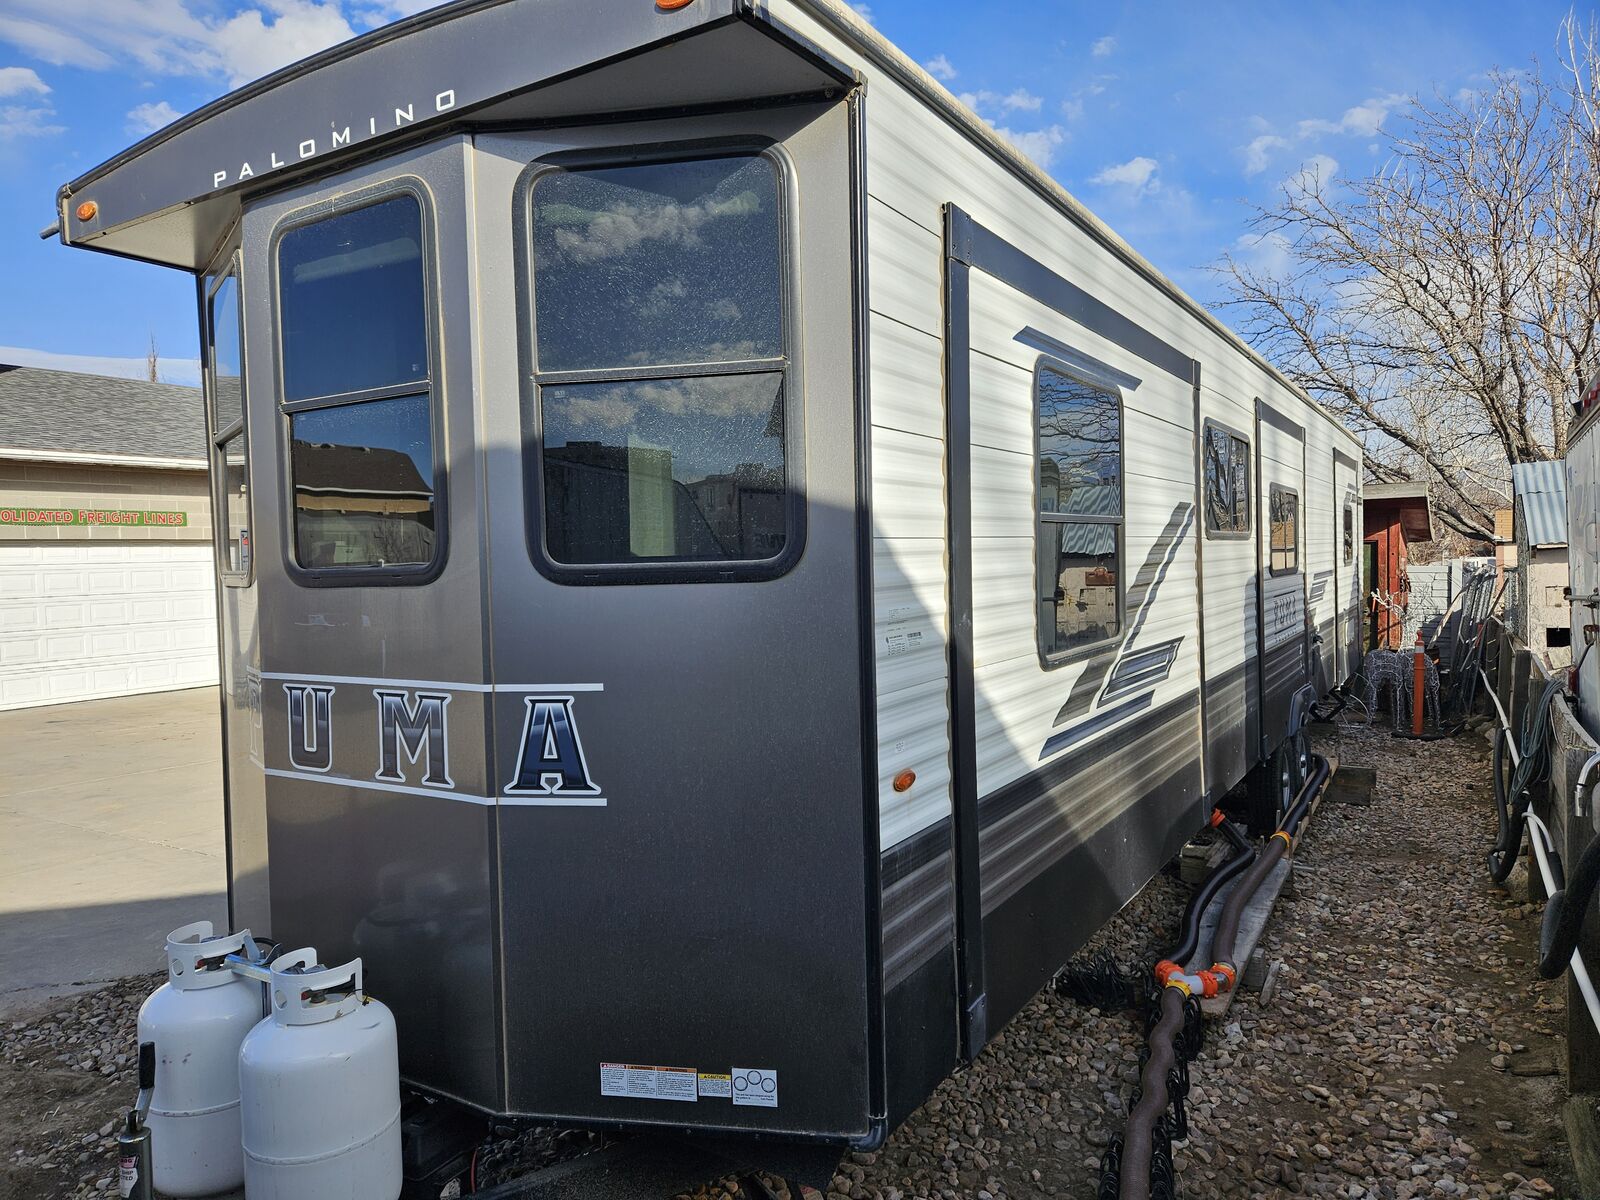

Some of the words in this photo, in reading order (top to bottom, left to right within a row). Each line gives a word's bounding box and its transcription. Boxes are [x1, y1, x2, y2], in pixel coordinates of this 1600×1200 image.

[213, 88, 456, 189] PALOMINO
[79, 510, 139, 525] FREIGHT
[143, 512, 184, 525] LINES
